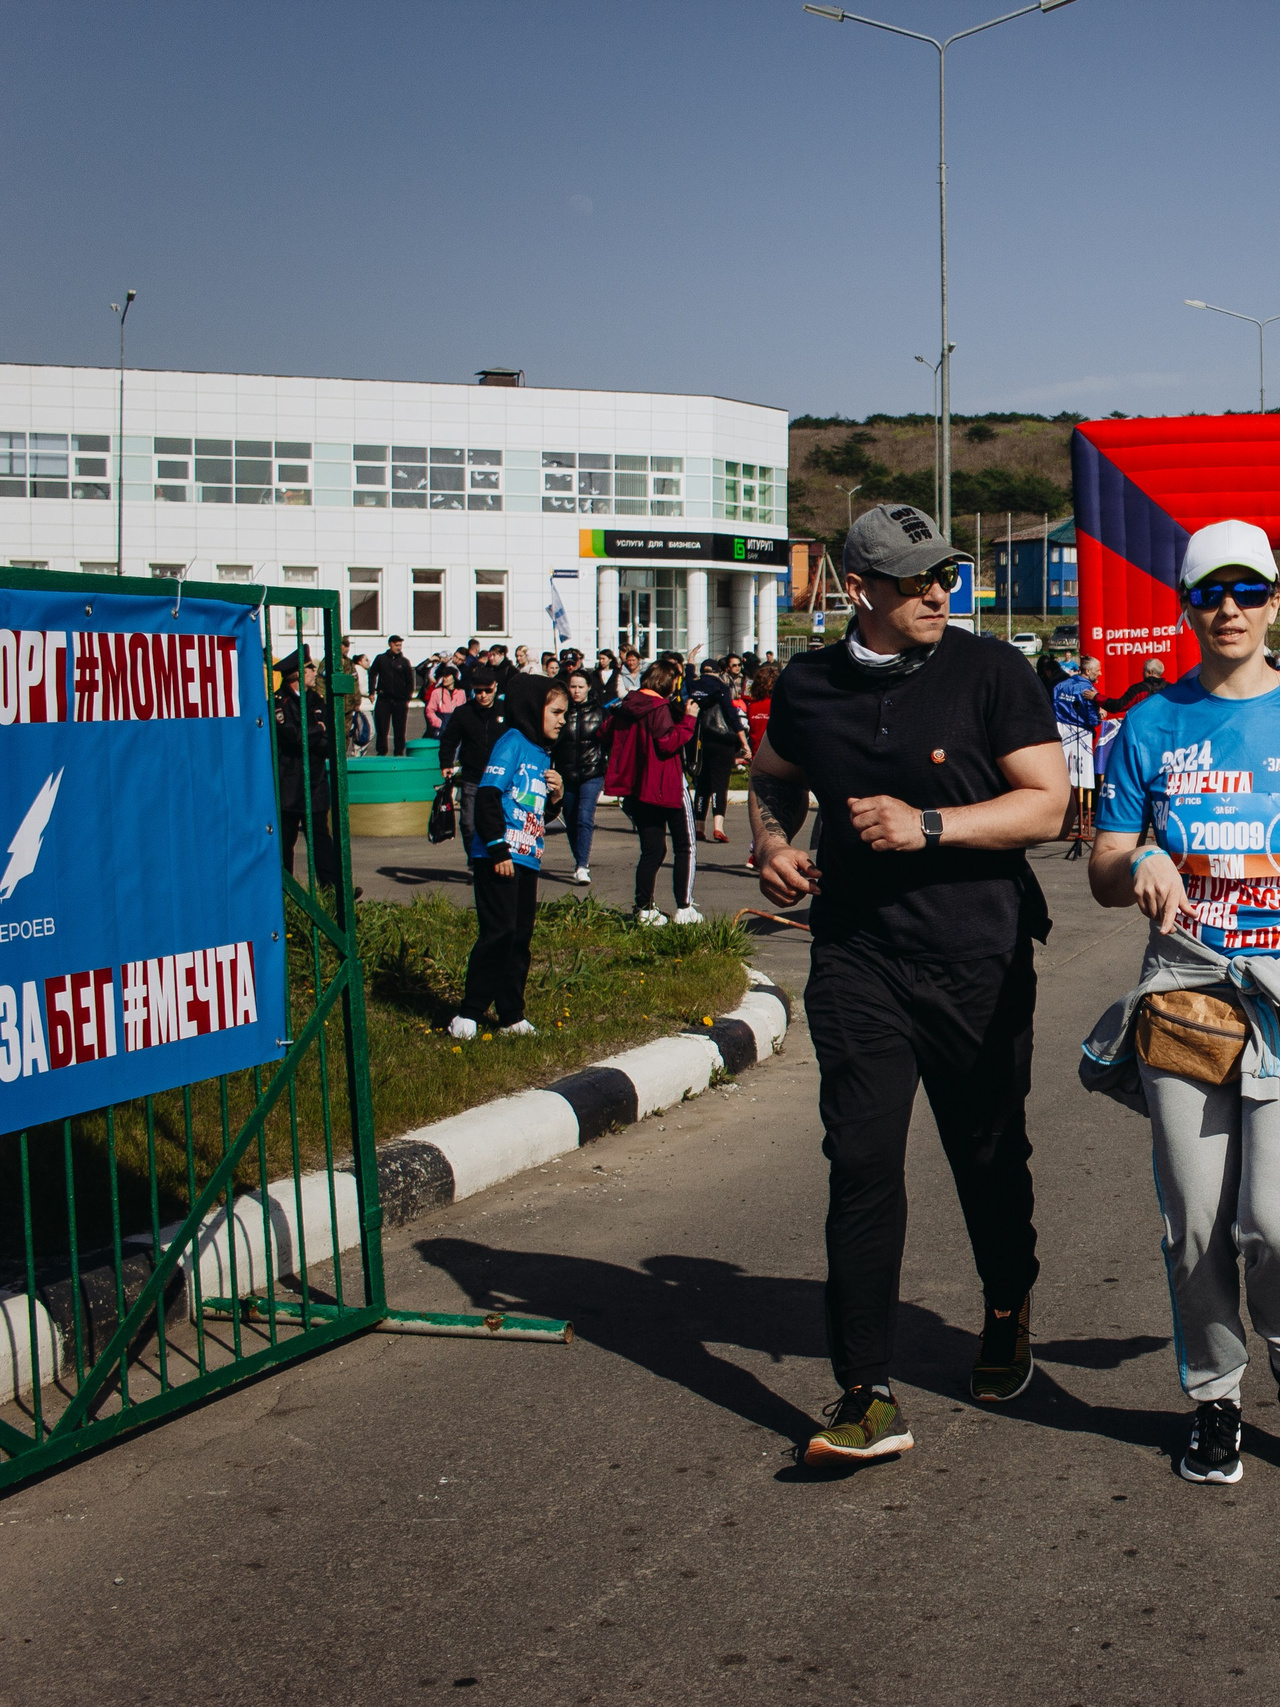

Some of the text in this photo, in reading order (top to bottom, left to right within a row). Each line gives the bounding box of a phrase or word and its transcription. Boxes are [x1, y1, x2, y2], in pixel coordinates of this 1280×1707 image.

[616, 539, 702, 549] УСЛУГИ ДЛЯ БИЗНЕСА
[747, 538, 774, 552] ИТУРУП
[1092, 626, 1104, 640] В
[1106, 627, 1150, 641] ритме
[1106, 640, 1172, 656] СТРАНЫ!
[73, 631, 240, 723] #МОМЕНТ
[1159, 739, 1213, 774] 2024
[1099, 783, 1116, 800] СБ
[1164, 771, 1253, 797] #МЕЧТА
[1184, 797, 1202, 806] ПСБ
[1190, 821, 1265, 850] 20009
[122, 941, 258, 1051] #МЕЧТА
